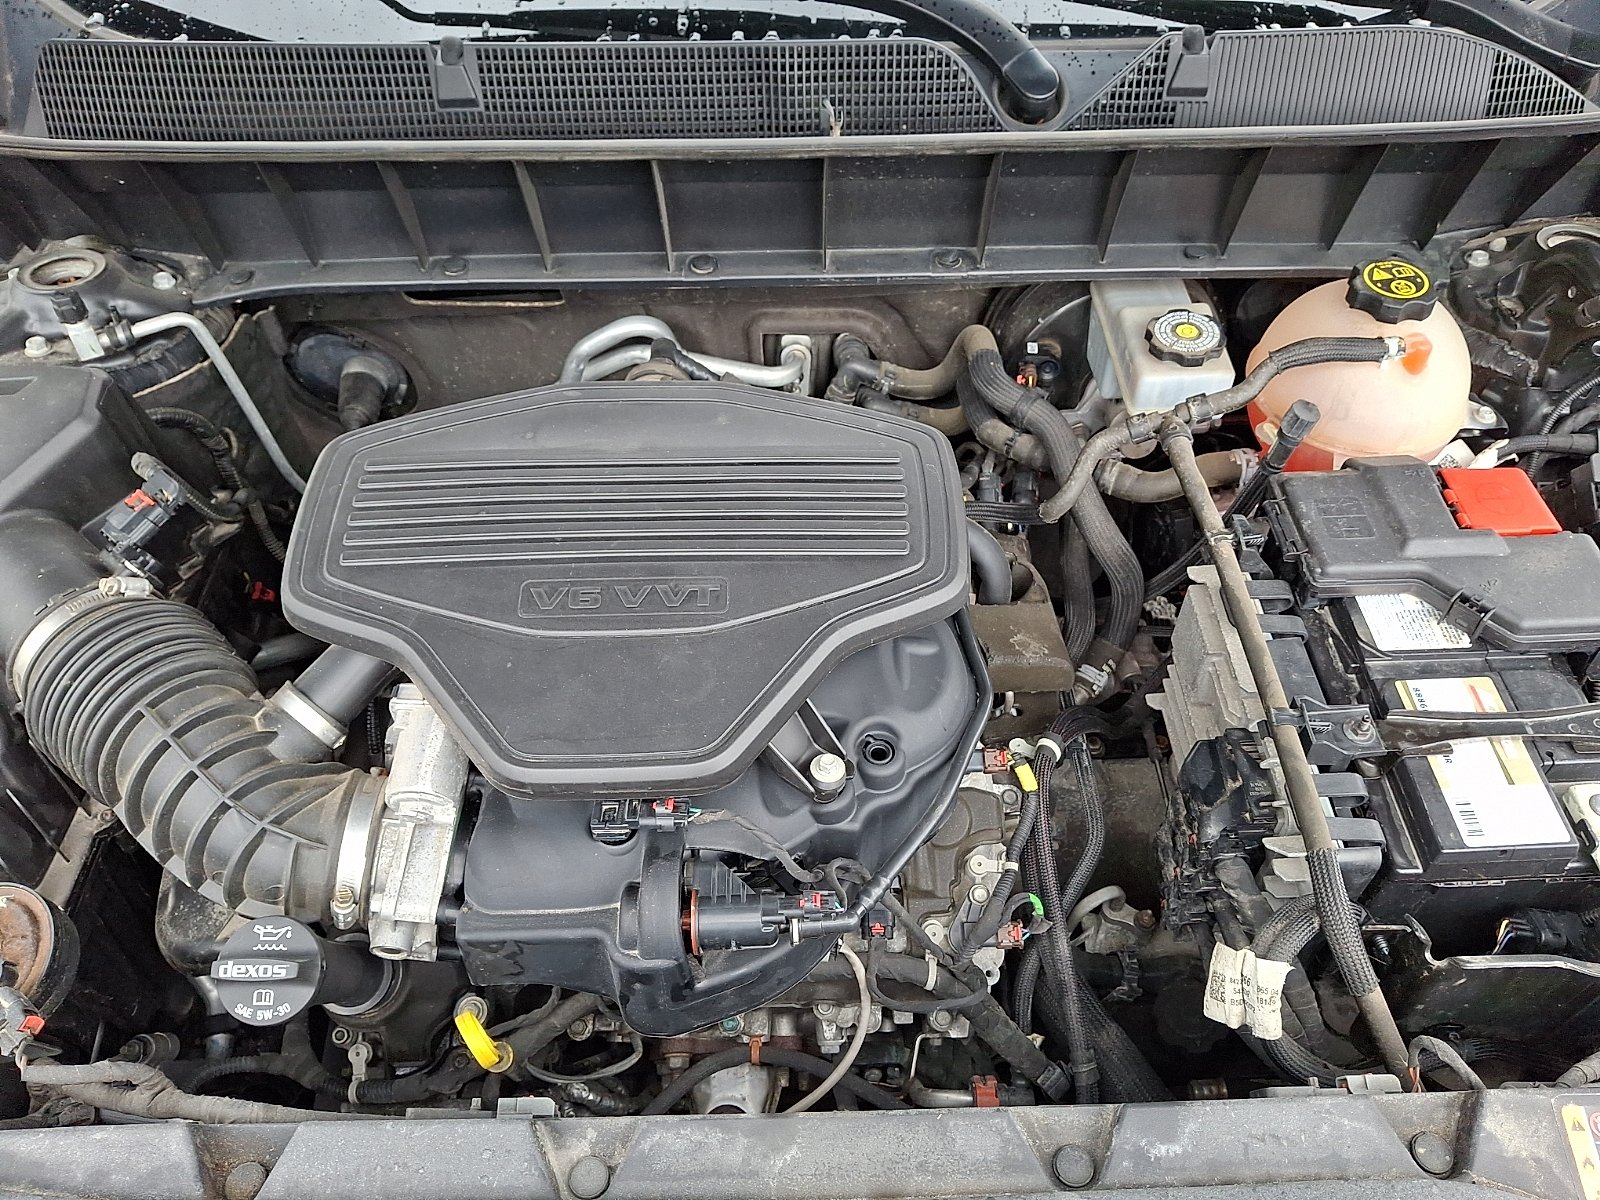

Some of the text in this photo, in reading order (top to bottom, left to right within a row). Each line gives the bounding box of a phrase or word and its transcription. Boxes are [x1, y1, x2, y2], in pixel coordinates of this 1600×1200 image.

[529, 584, 721, 610] V6 VVT
[218, 960, 288, 979] dexos
[234, 1002, 291, 1021] SAE 5W-30
